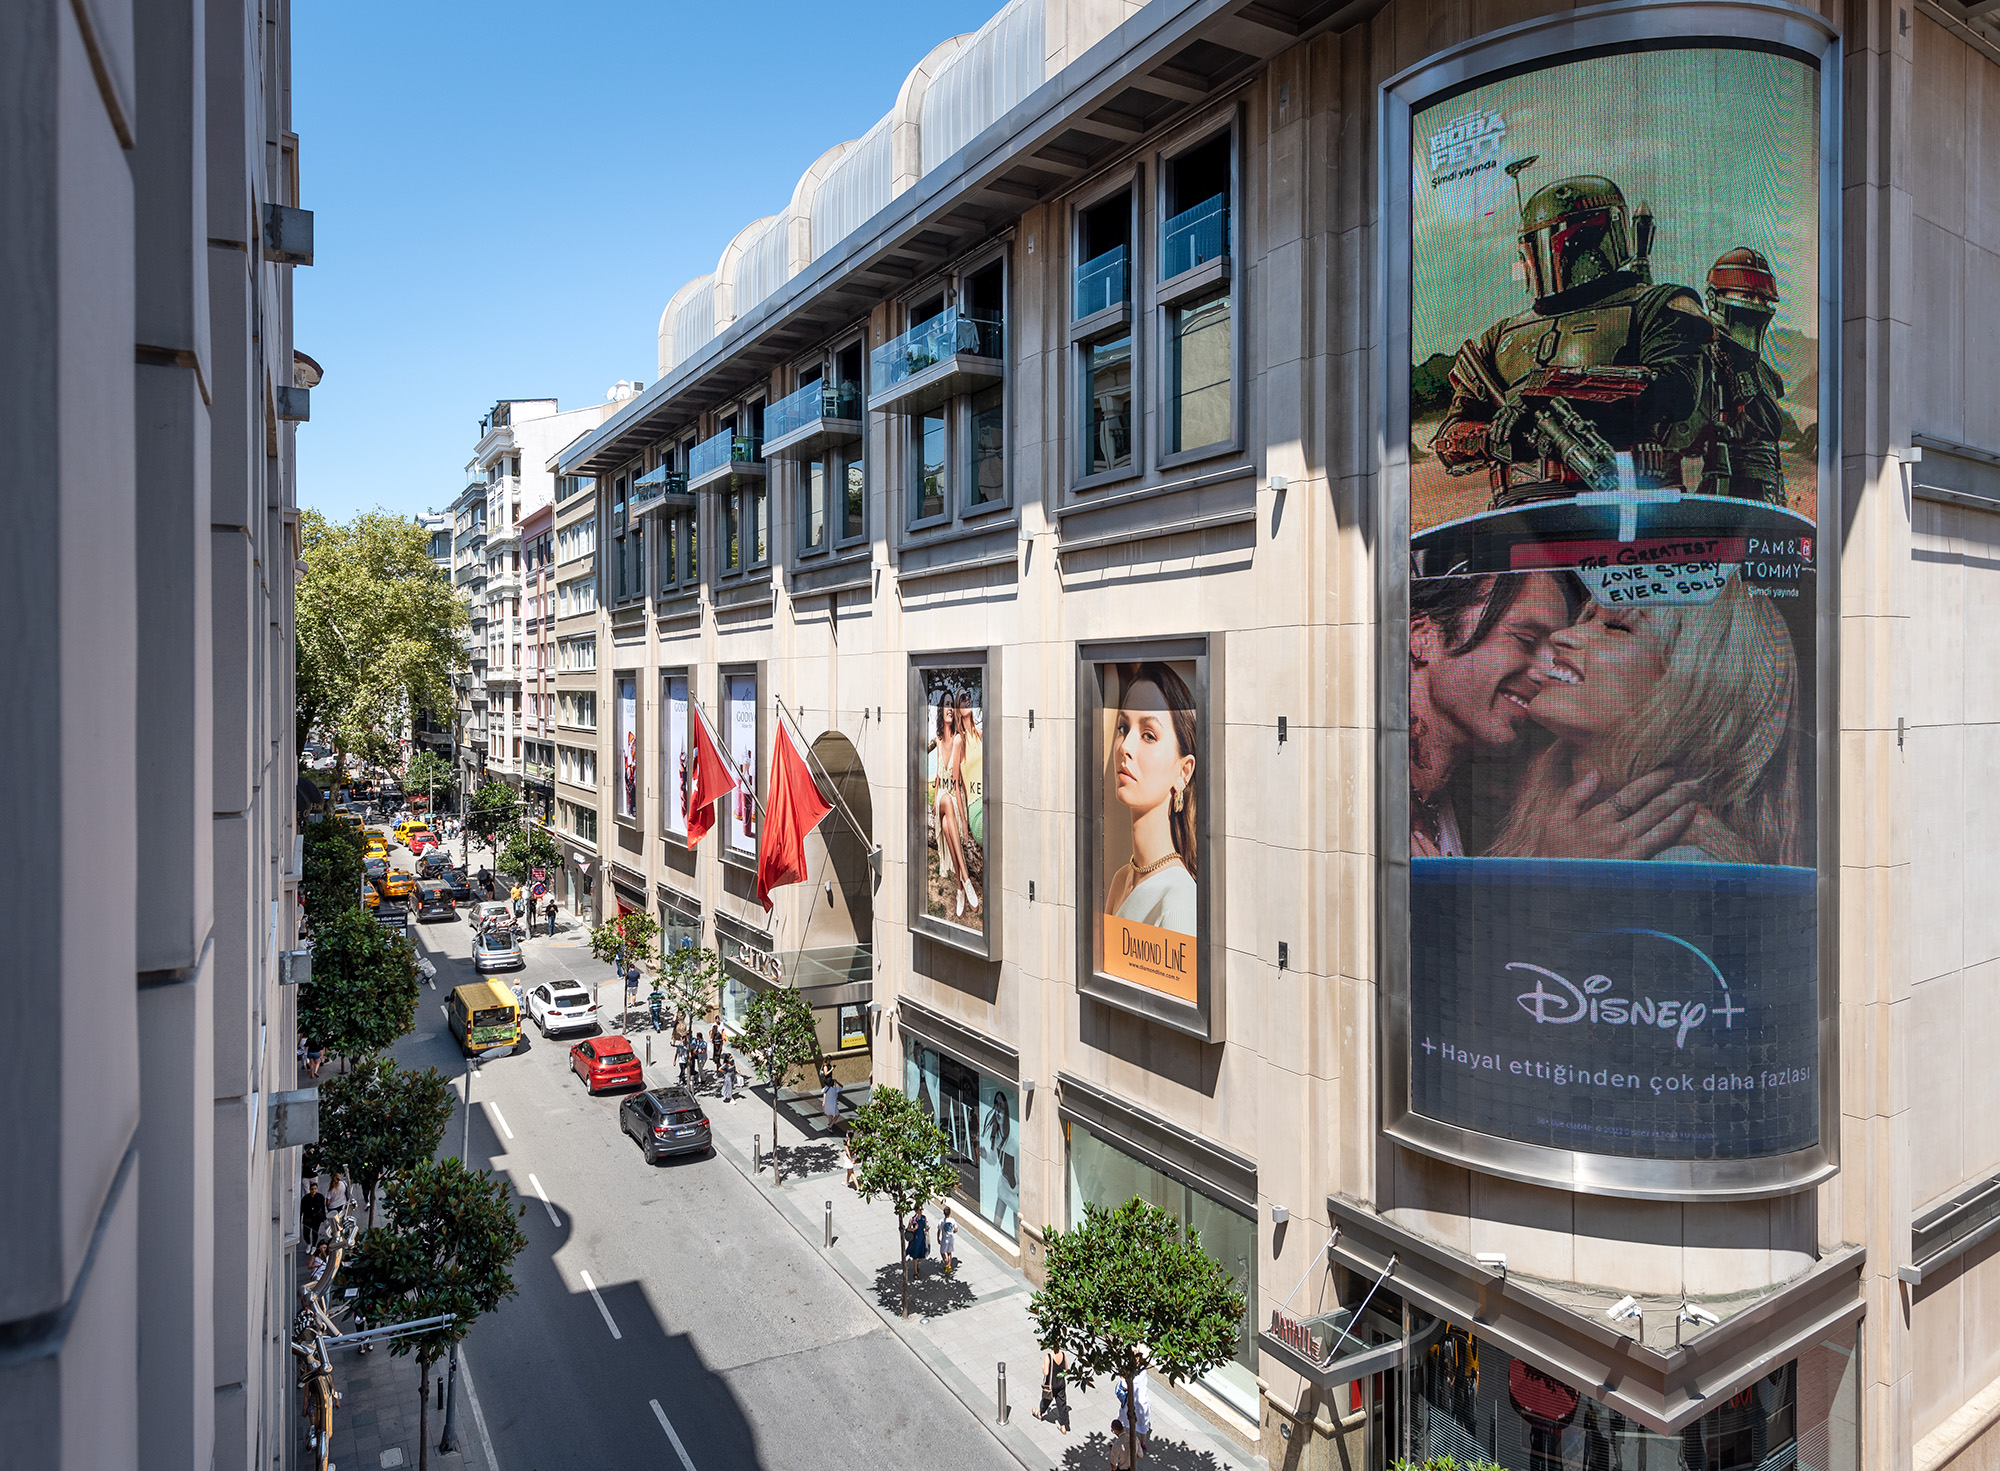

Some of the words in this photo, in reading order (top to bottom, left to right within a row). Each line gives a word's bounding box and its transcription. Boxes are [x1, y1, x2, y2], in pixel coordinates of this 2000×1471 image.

[1430, 113, 1506, 154] BOBA
[1430, 131, 1506, 172] FETT
[1579, 555, 1609, 571] THE
[1617, 540, 1719, 565] GREATEST
[1745, 561, 1801, 579] TOMMY
[1602, 567, 1649, 588] LOVE
[1656, 558, 1722, 577] STORY
[1610, 584, 1668, 601] EVER
[1676, 577, 1726, 594] SOLD
[932, 777, 963, 792] JIMMY
[1122, 927, 1162, 966] DIAMOND
[1164, 938, 1187, 974] LINE
[1509, 1059, 1641, 1088] ettiğinden
[1649, 1073, 1695, 1096] çok
[1703, 1073, 1755, 1091] daha
[1761, 1066, 1811, 1088] fazlası
